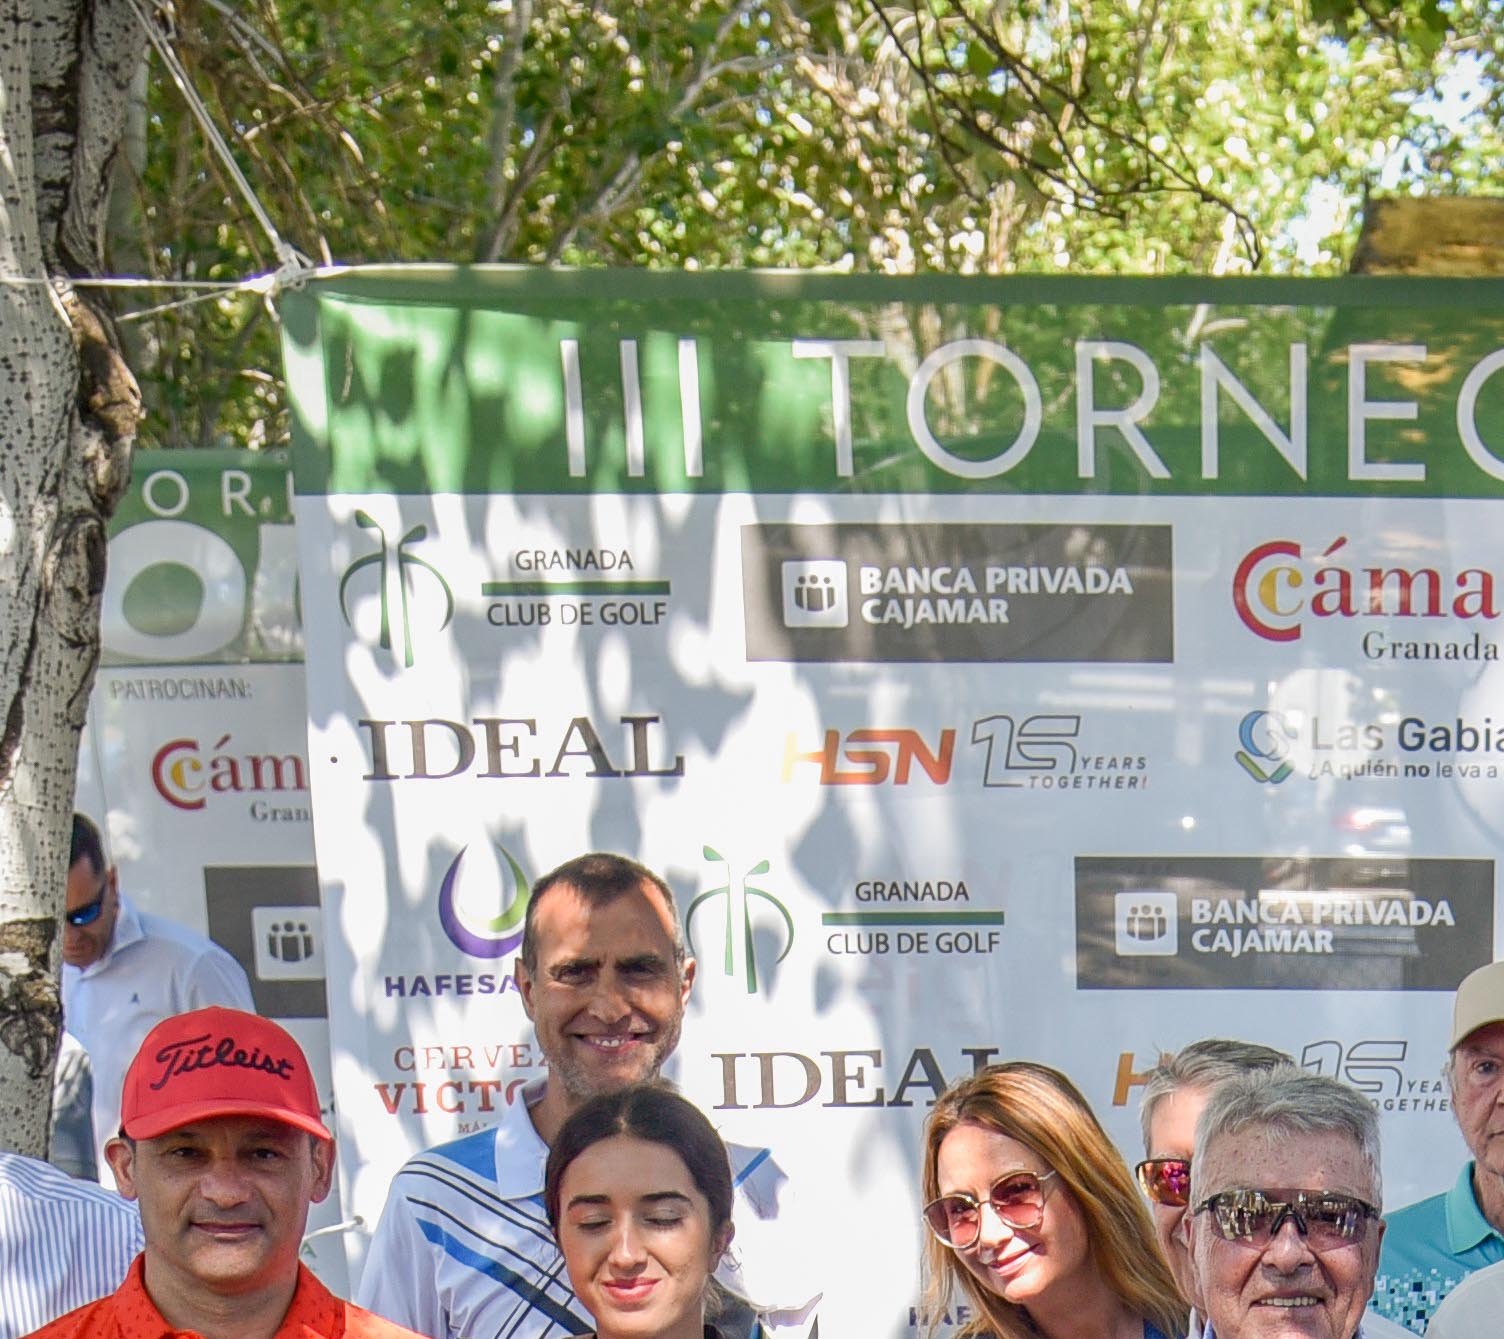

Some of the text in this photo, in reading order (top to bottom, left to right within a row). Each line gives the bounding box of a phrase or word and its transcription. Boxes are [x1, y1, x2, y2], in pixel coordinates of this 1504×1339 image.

[561, 339, 703, 477] III
[515, 550, 632, 571] GRANADA
[860, 566, 1133, 595] BANCA PRIVADA
[487, 602, 668, 626] CLUB DE GOLF
[862, 599, 1008, 628] CAJAMAR
[1361, 630, 1499, 662] Granada
[112, 678, 253, 700] PATROCINAN:
[1311, 717, 1384, 752] Las
[358, 715, 684, 781] IDEAL
[1081, 756, 1146, 771] YEARS
[1340, 758, 1397, 780] quién
[1404, 763, 1430, 779] no
[1436, 761, 1453, 779] le
[1458, 765, 1482, 779] va
[1488, 765, 1499, 779] a
[1029, 775, 1147, 789] TOGETHER!
[250, 801, 310, 822] Gran
[856, 881, 969, 903] GRANADA
[1192, 899, 1455, 927] BANCA PRIVADA
[827, 931, 1000, 955] CLUB DE GOLF
[1192, 928, 1334, 957] CAJAMAR
[150, 1034, 294, 1090] Titleist
